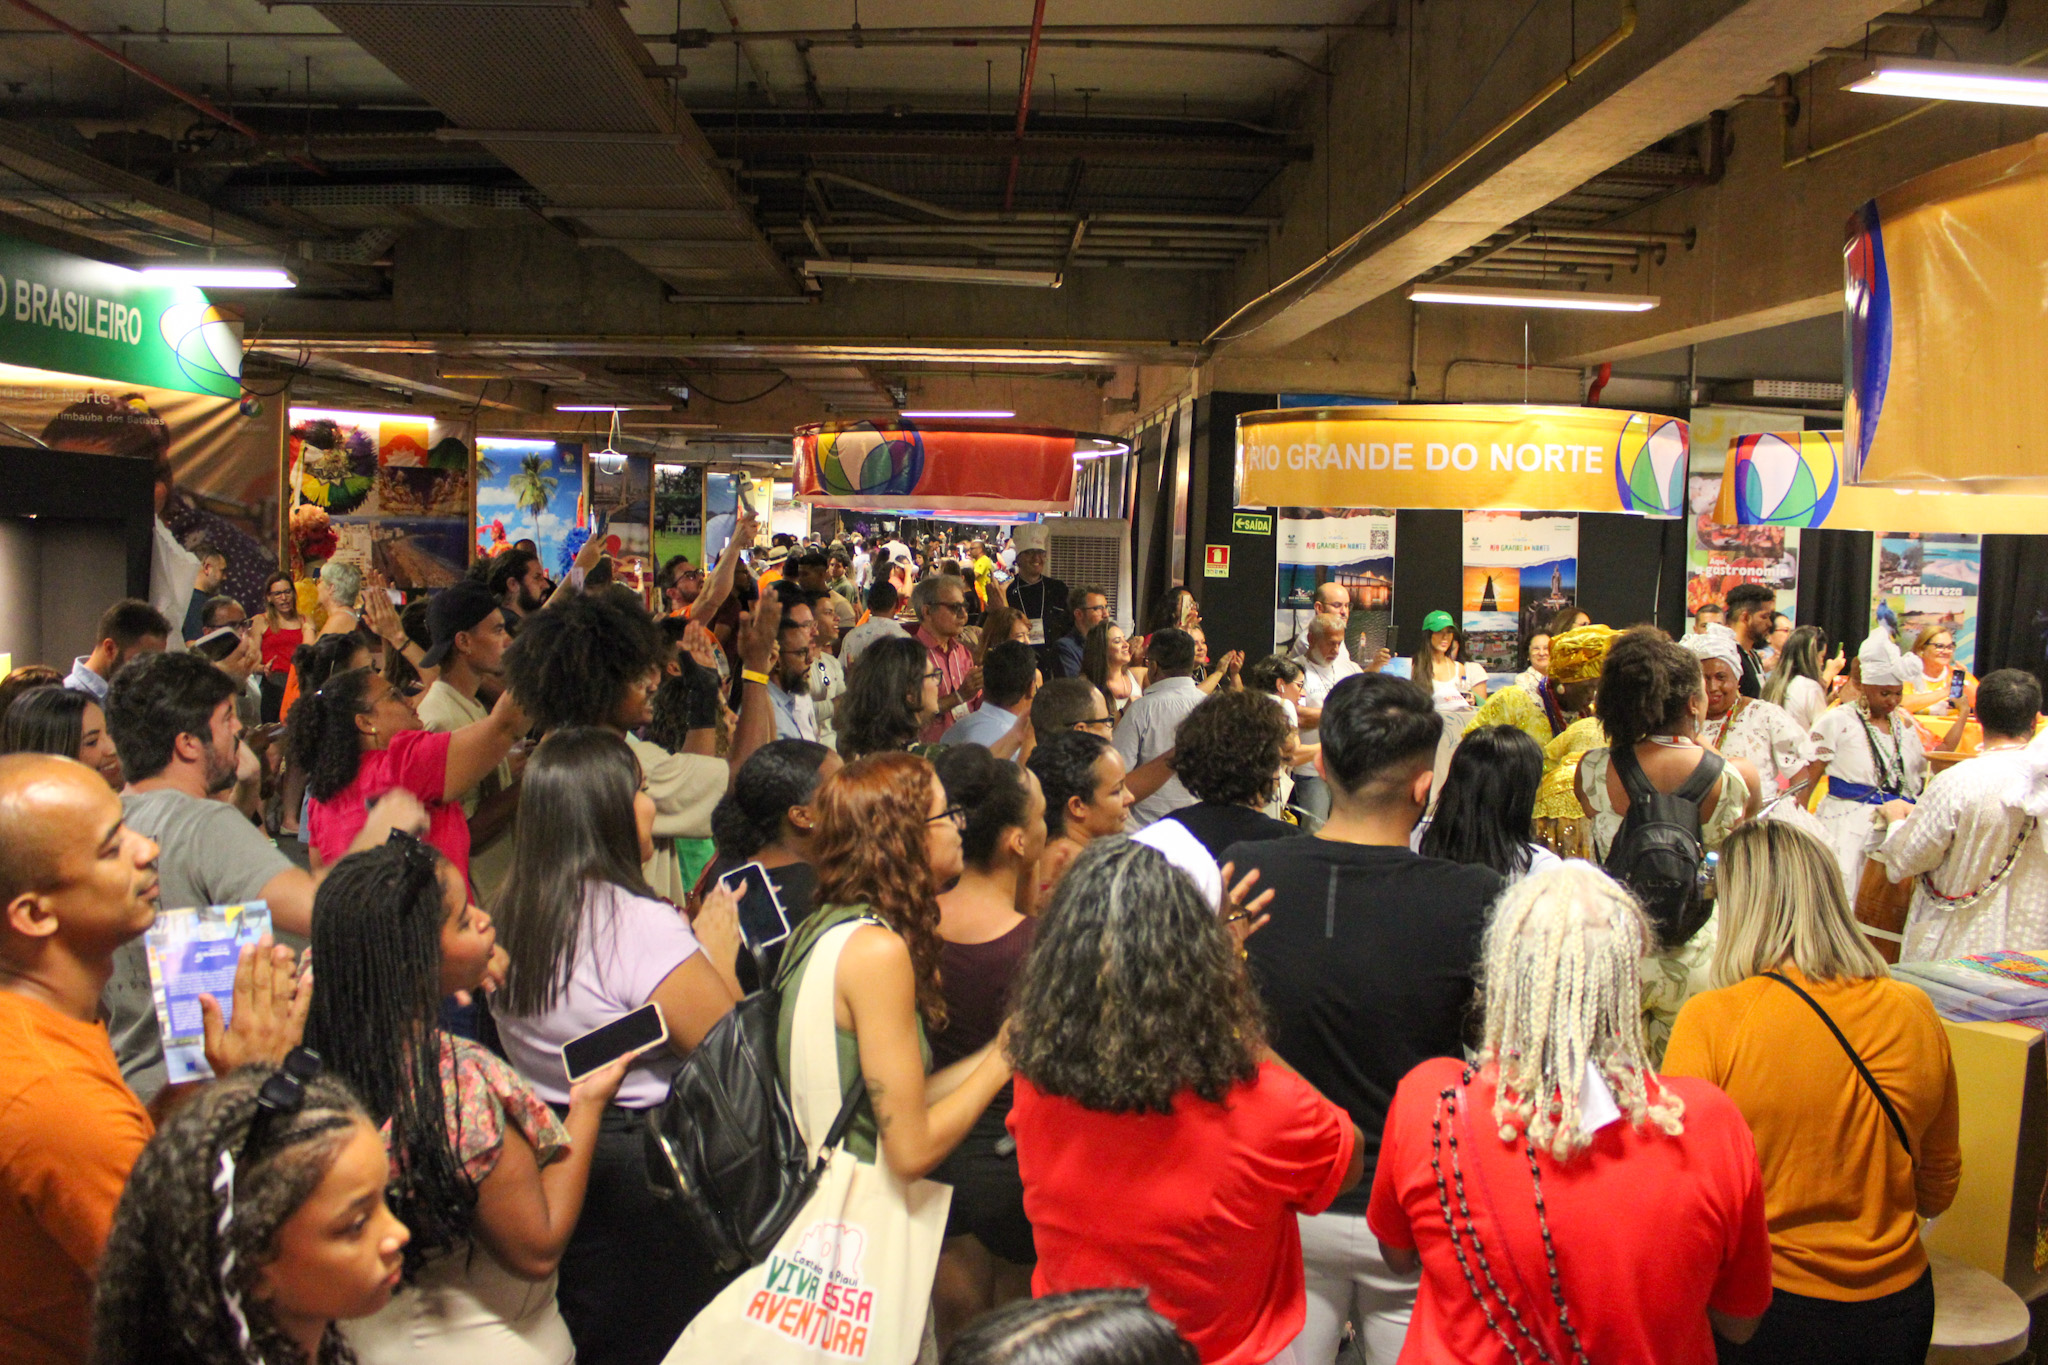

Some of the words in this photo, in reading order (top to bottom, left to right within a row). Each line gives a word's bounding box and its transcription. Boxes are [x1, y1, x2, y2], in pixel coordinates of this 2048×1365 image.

[15, 279, 142, 345] BRASILEIRO
[63, 388, 111, 405] Norte
[1249, 445, 1280, 471] RIO
[1286, 443, 1414, 471] GRANDE
[1426, 443, 1479, 472] DO
[1489, 443, 1604, 474] NORTE
[1244, 518, 1269, 531] SAÍDA
[1705, 563, 1790, 578] gastronomia
[1892, 585, 1901, 595] a
[1903, 584, 1963, 596] natureza
[766, 1255, 820, 1301] VIVA
[821, 1281, 874, 1323] ESSA
[746, 1290, 869, 1358] AVENTURA
